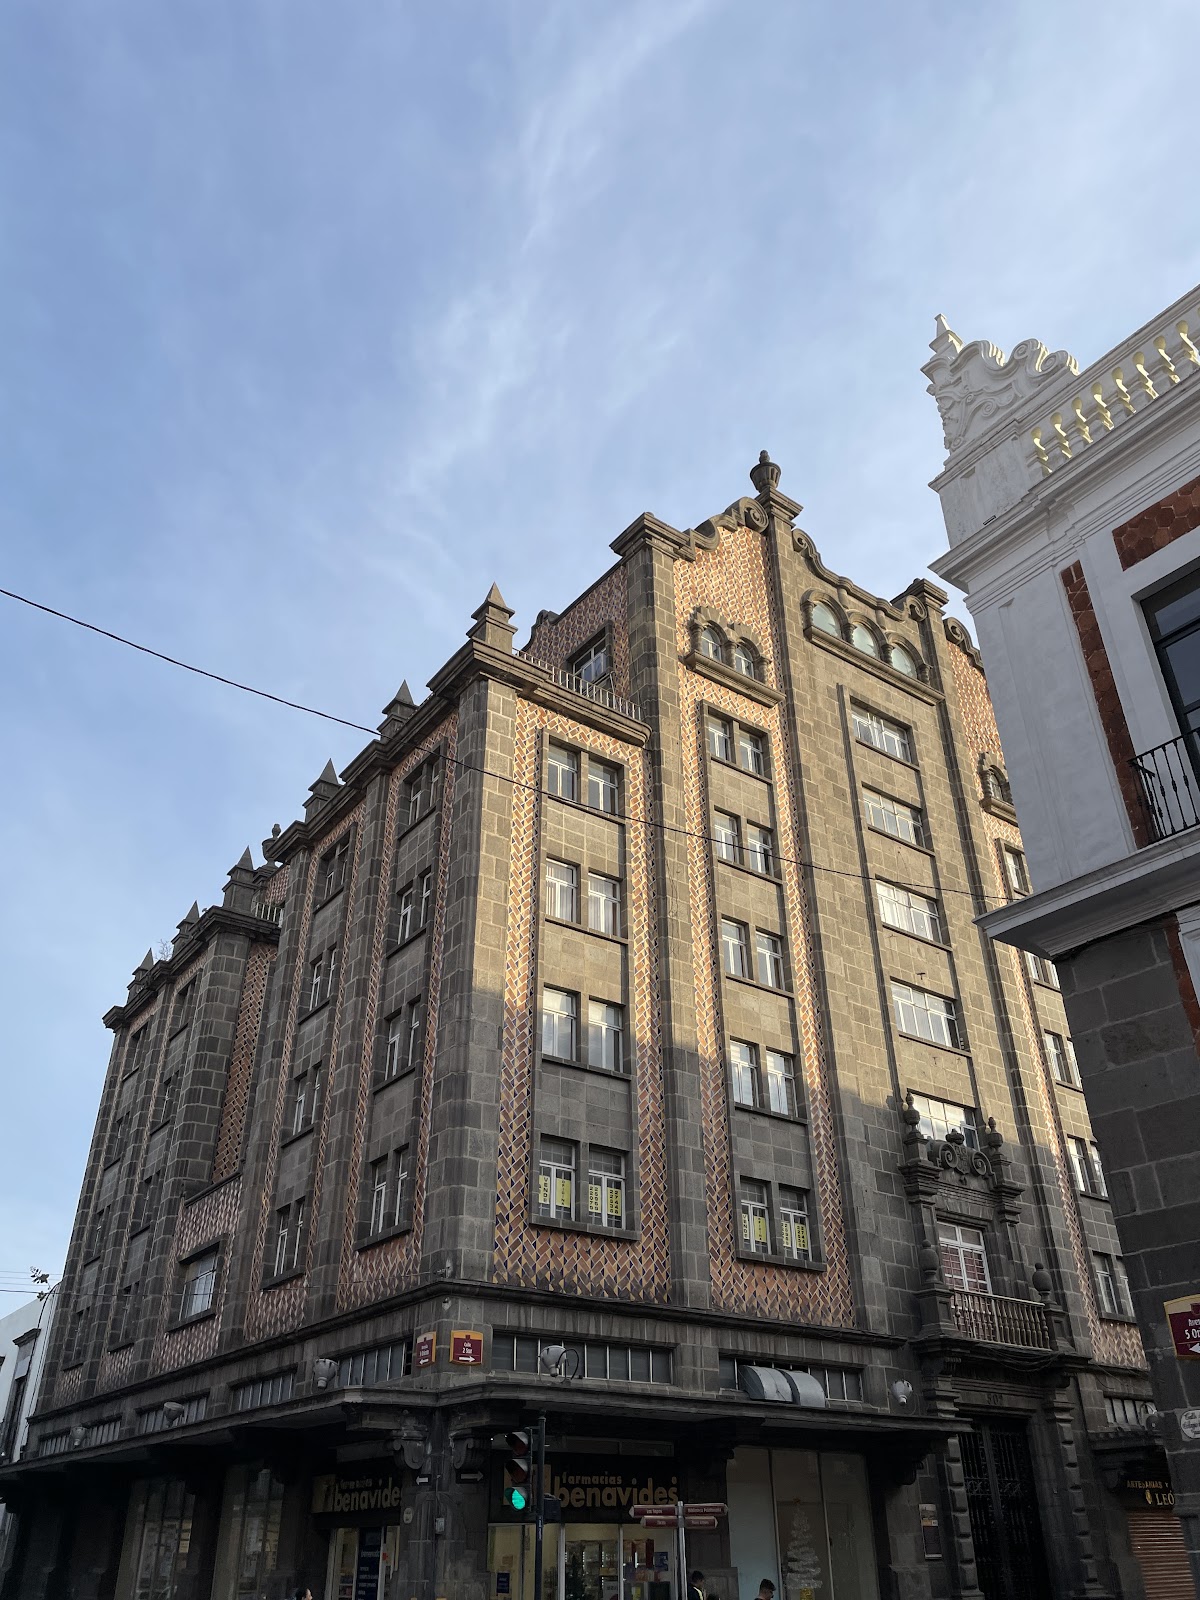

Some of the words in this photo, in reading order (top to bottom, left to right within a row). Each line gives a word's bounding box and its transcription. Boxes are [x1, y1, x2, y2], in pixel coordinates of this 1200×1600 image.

[1184, 1329, 1191, 1340] 5
[562, 1471, 623, 1485] farmacias
[553, 1475, 678, 1508] benavides
